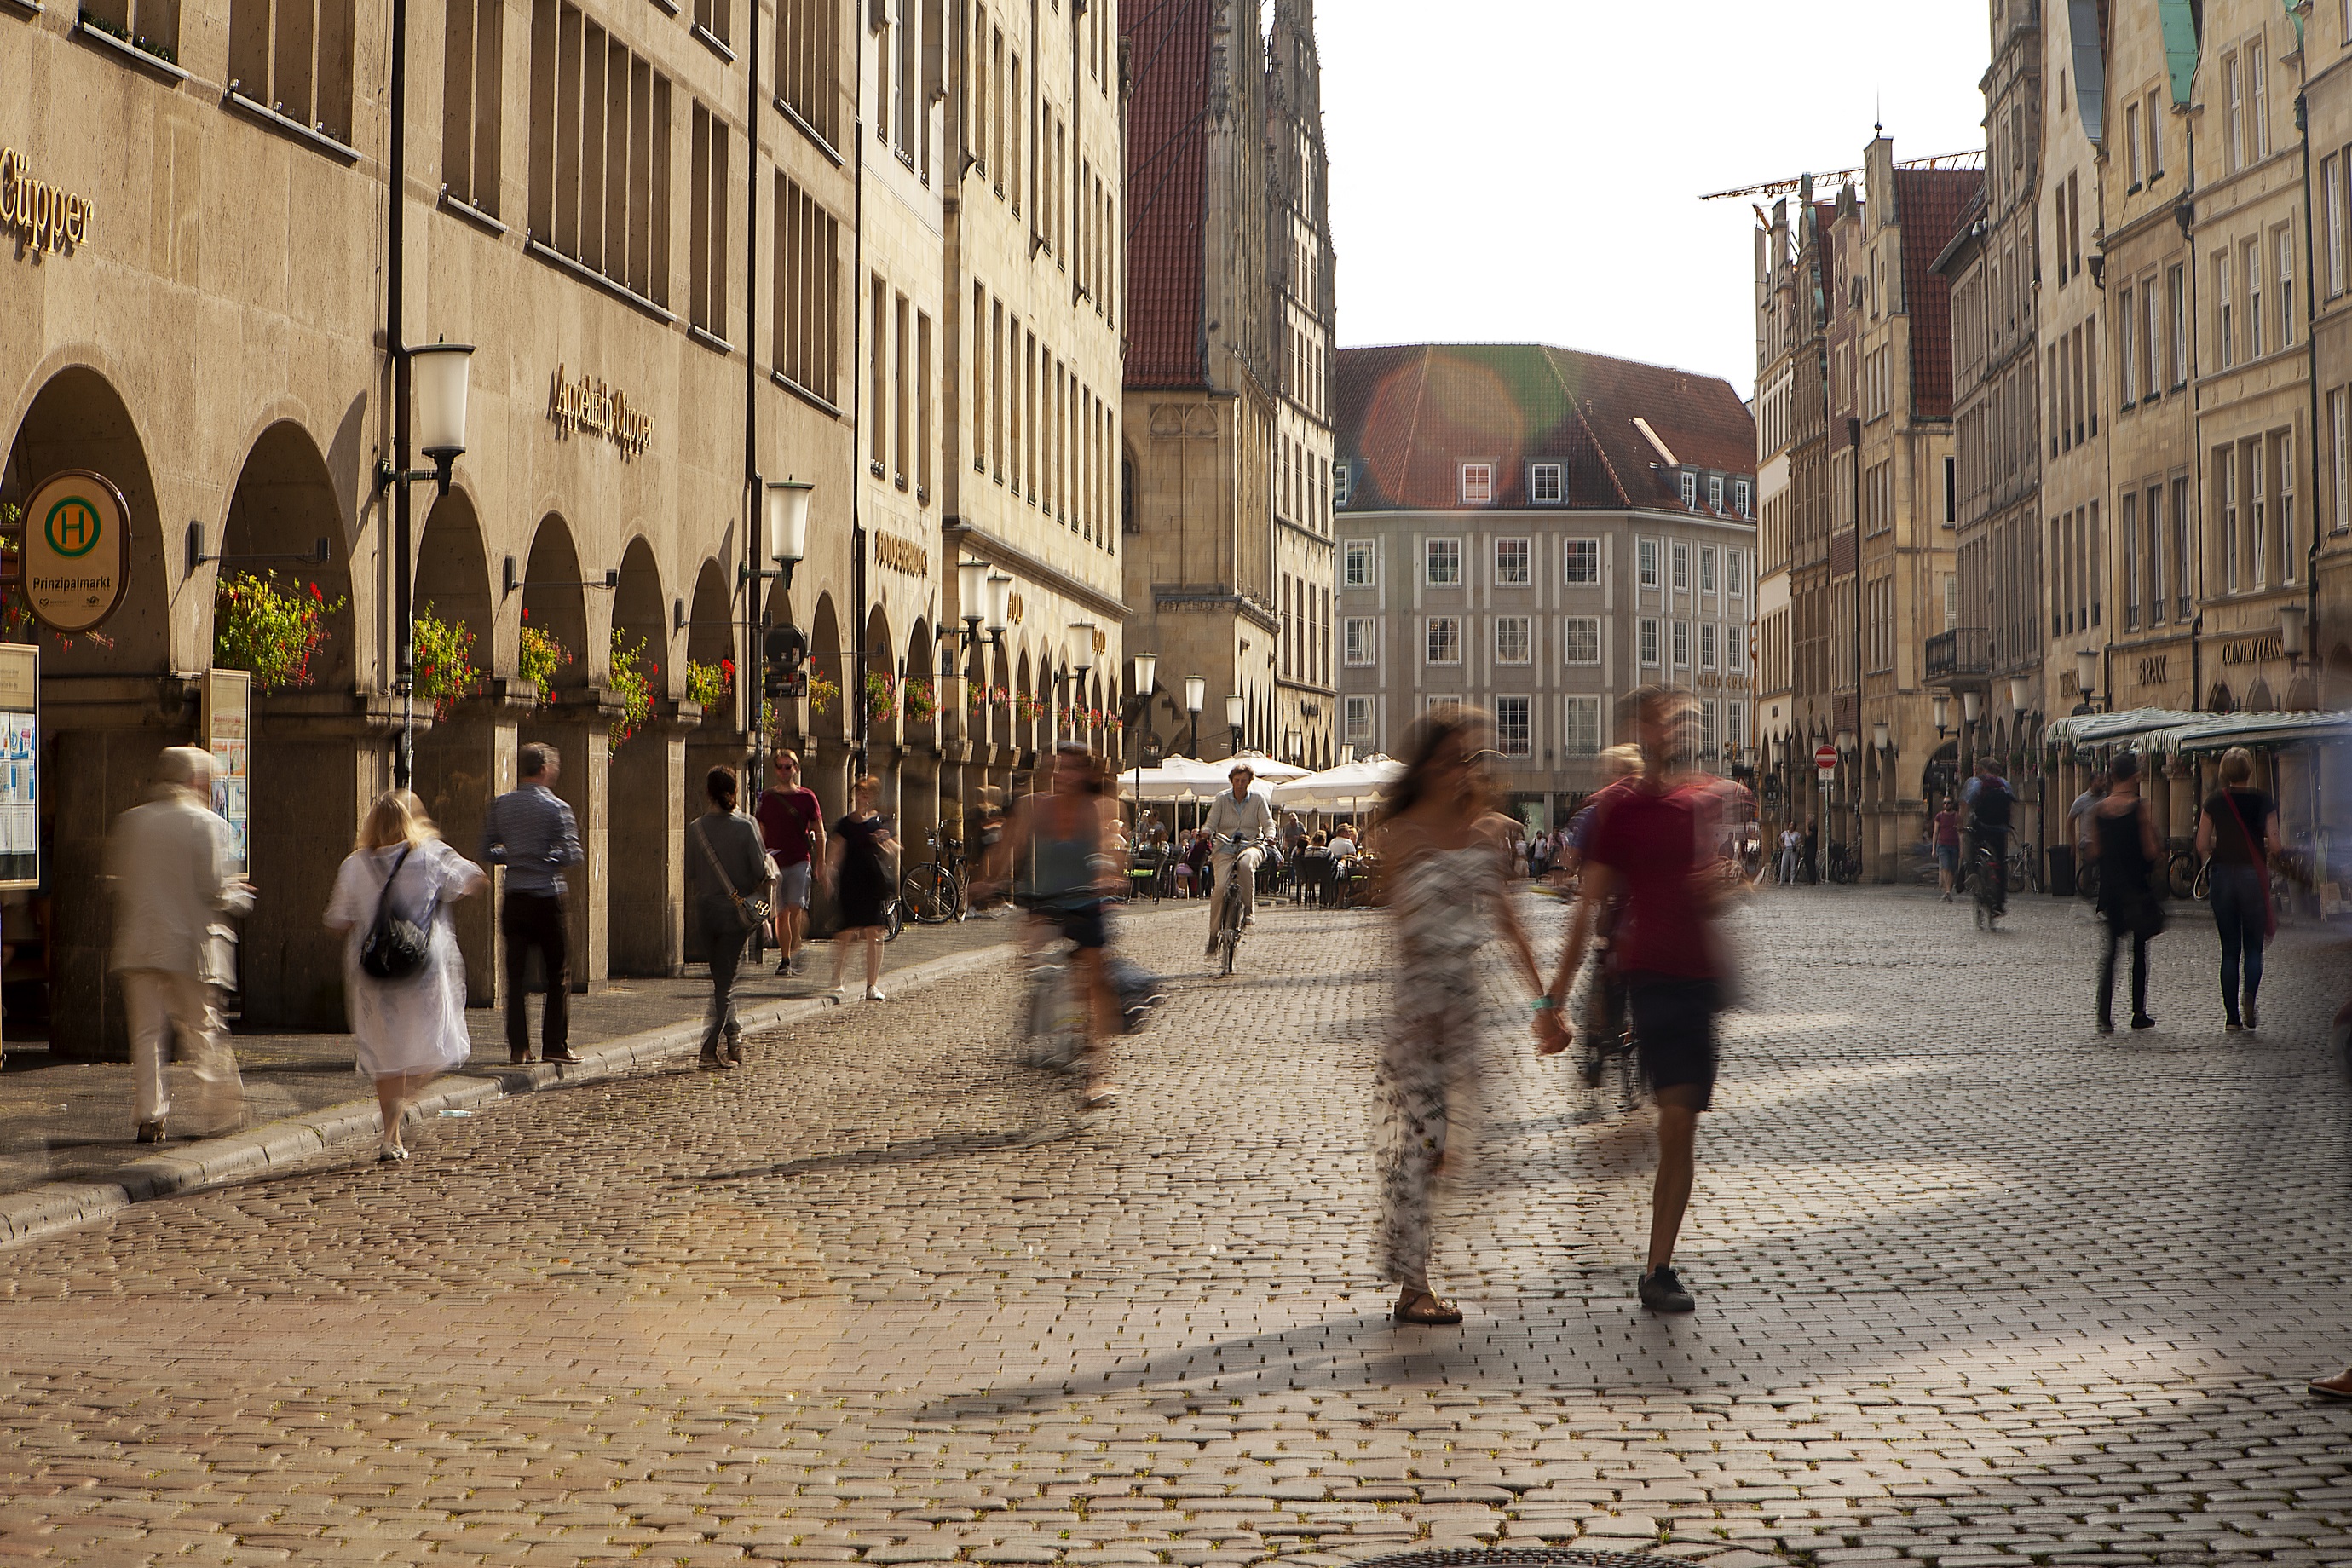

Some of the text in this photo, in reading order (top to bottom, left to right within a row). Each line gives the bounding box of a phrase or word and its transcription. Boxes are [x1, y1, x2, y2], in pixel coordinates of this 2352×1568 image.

[556, 363, 654, 458] Appelrath-Cüpper
[61, 509, 84, 545] H
[32, 576, 111, 594] Prinzipalmarkt
[2222, 638, 2257, 665] COUNTRY
[2137, 654, 2167, 685] BRAX
